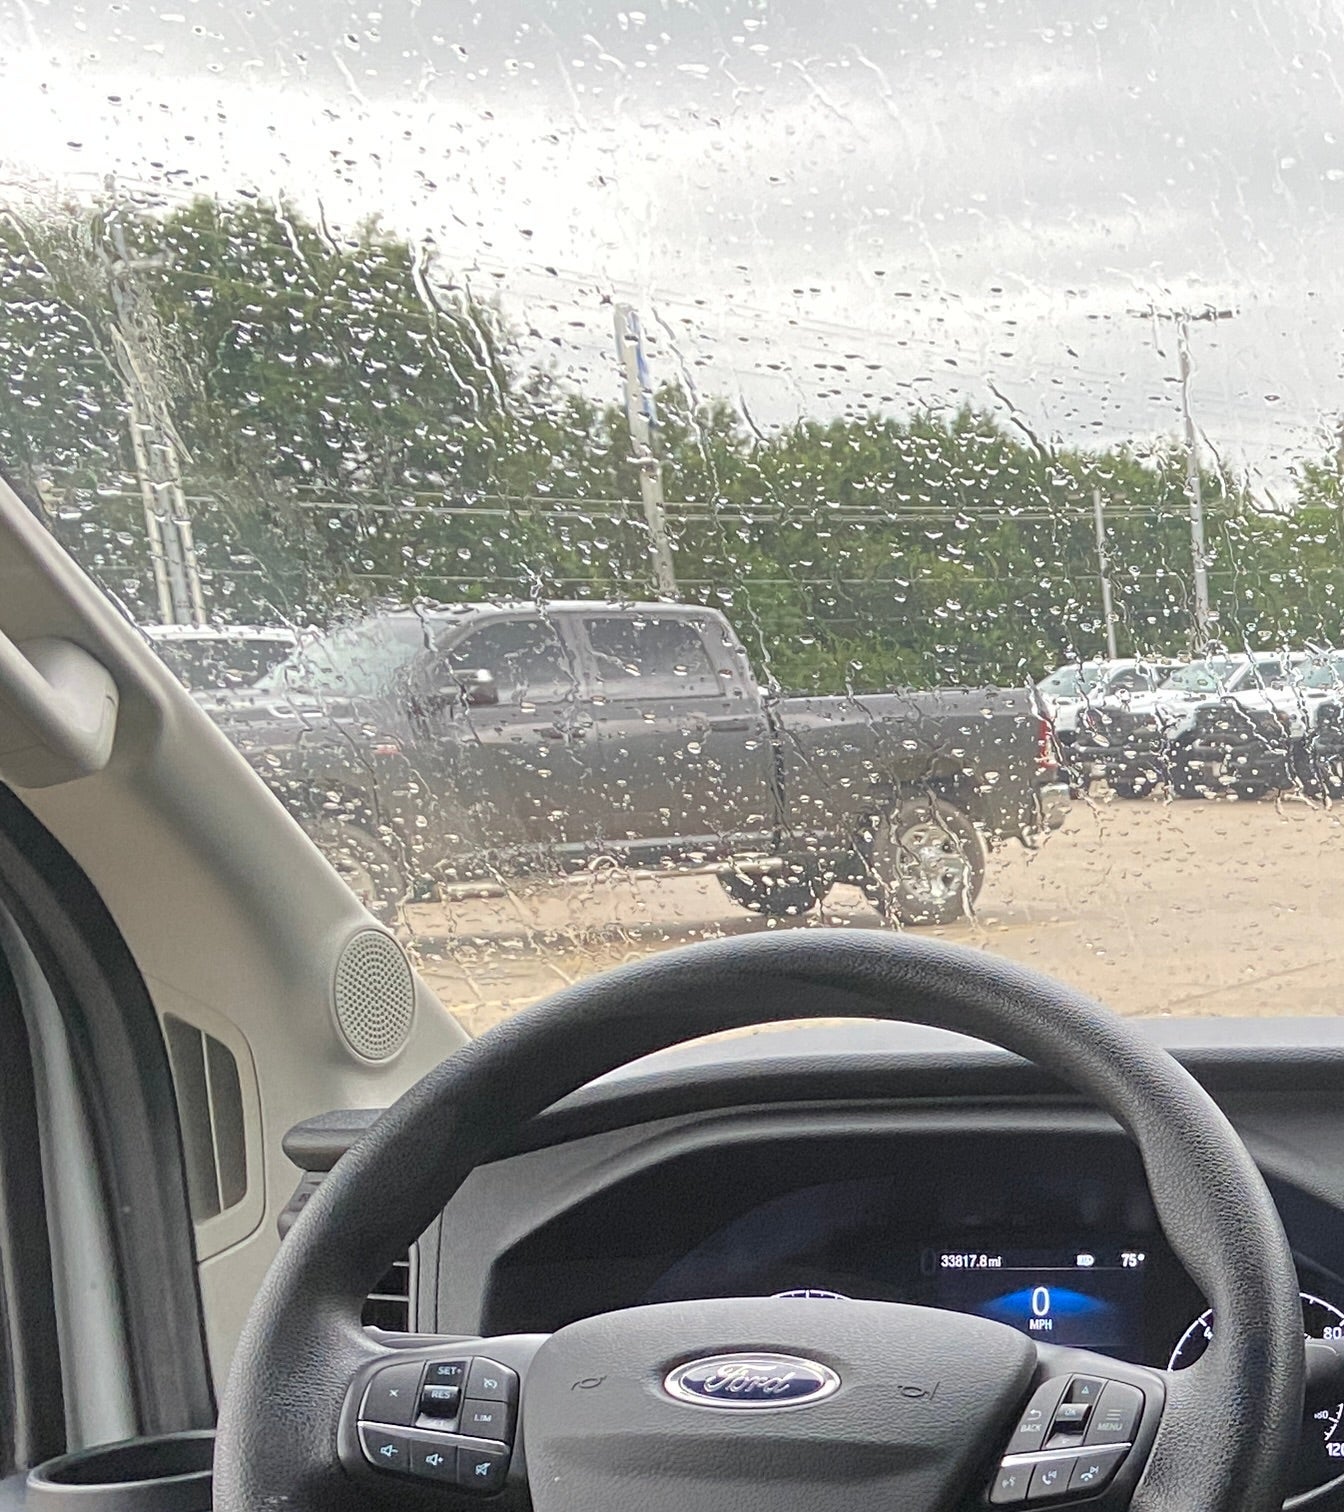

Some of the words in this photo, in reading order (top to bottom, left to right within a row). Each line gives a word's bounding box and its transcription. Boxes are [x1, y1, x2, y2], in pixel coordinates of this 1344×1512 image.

[941, 1254, 988, 1268] 33817.8
[1031, 1286, 1050, 1316] 0
[1029, 1319, 1052, 1330] MPH
[1323, 1327, 1342, 1340] 80
[703, 1363, 792, 1394] Ford
[431, 1389, 450, 1399] RES
[474, 1413, 492, 1422] LIM
[1020, 1423, 1042, 1433] BACK
[1096, 1422, 1122, 1432] MENU
